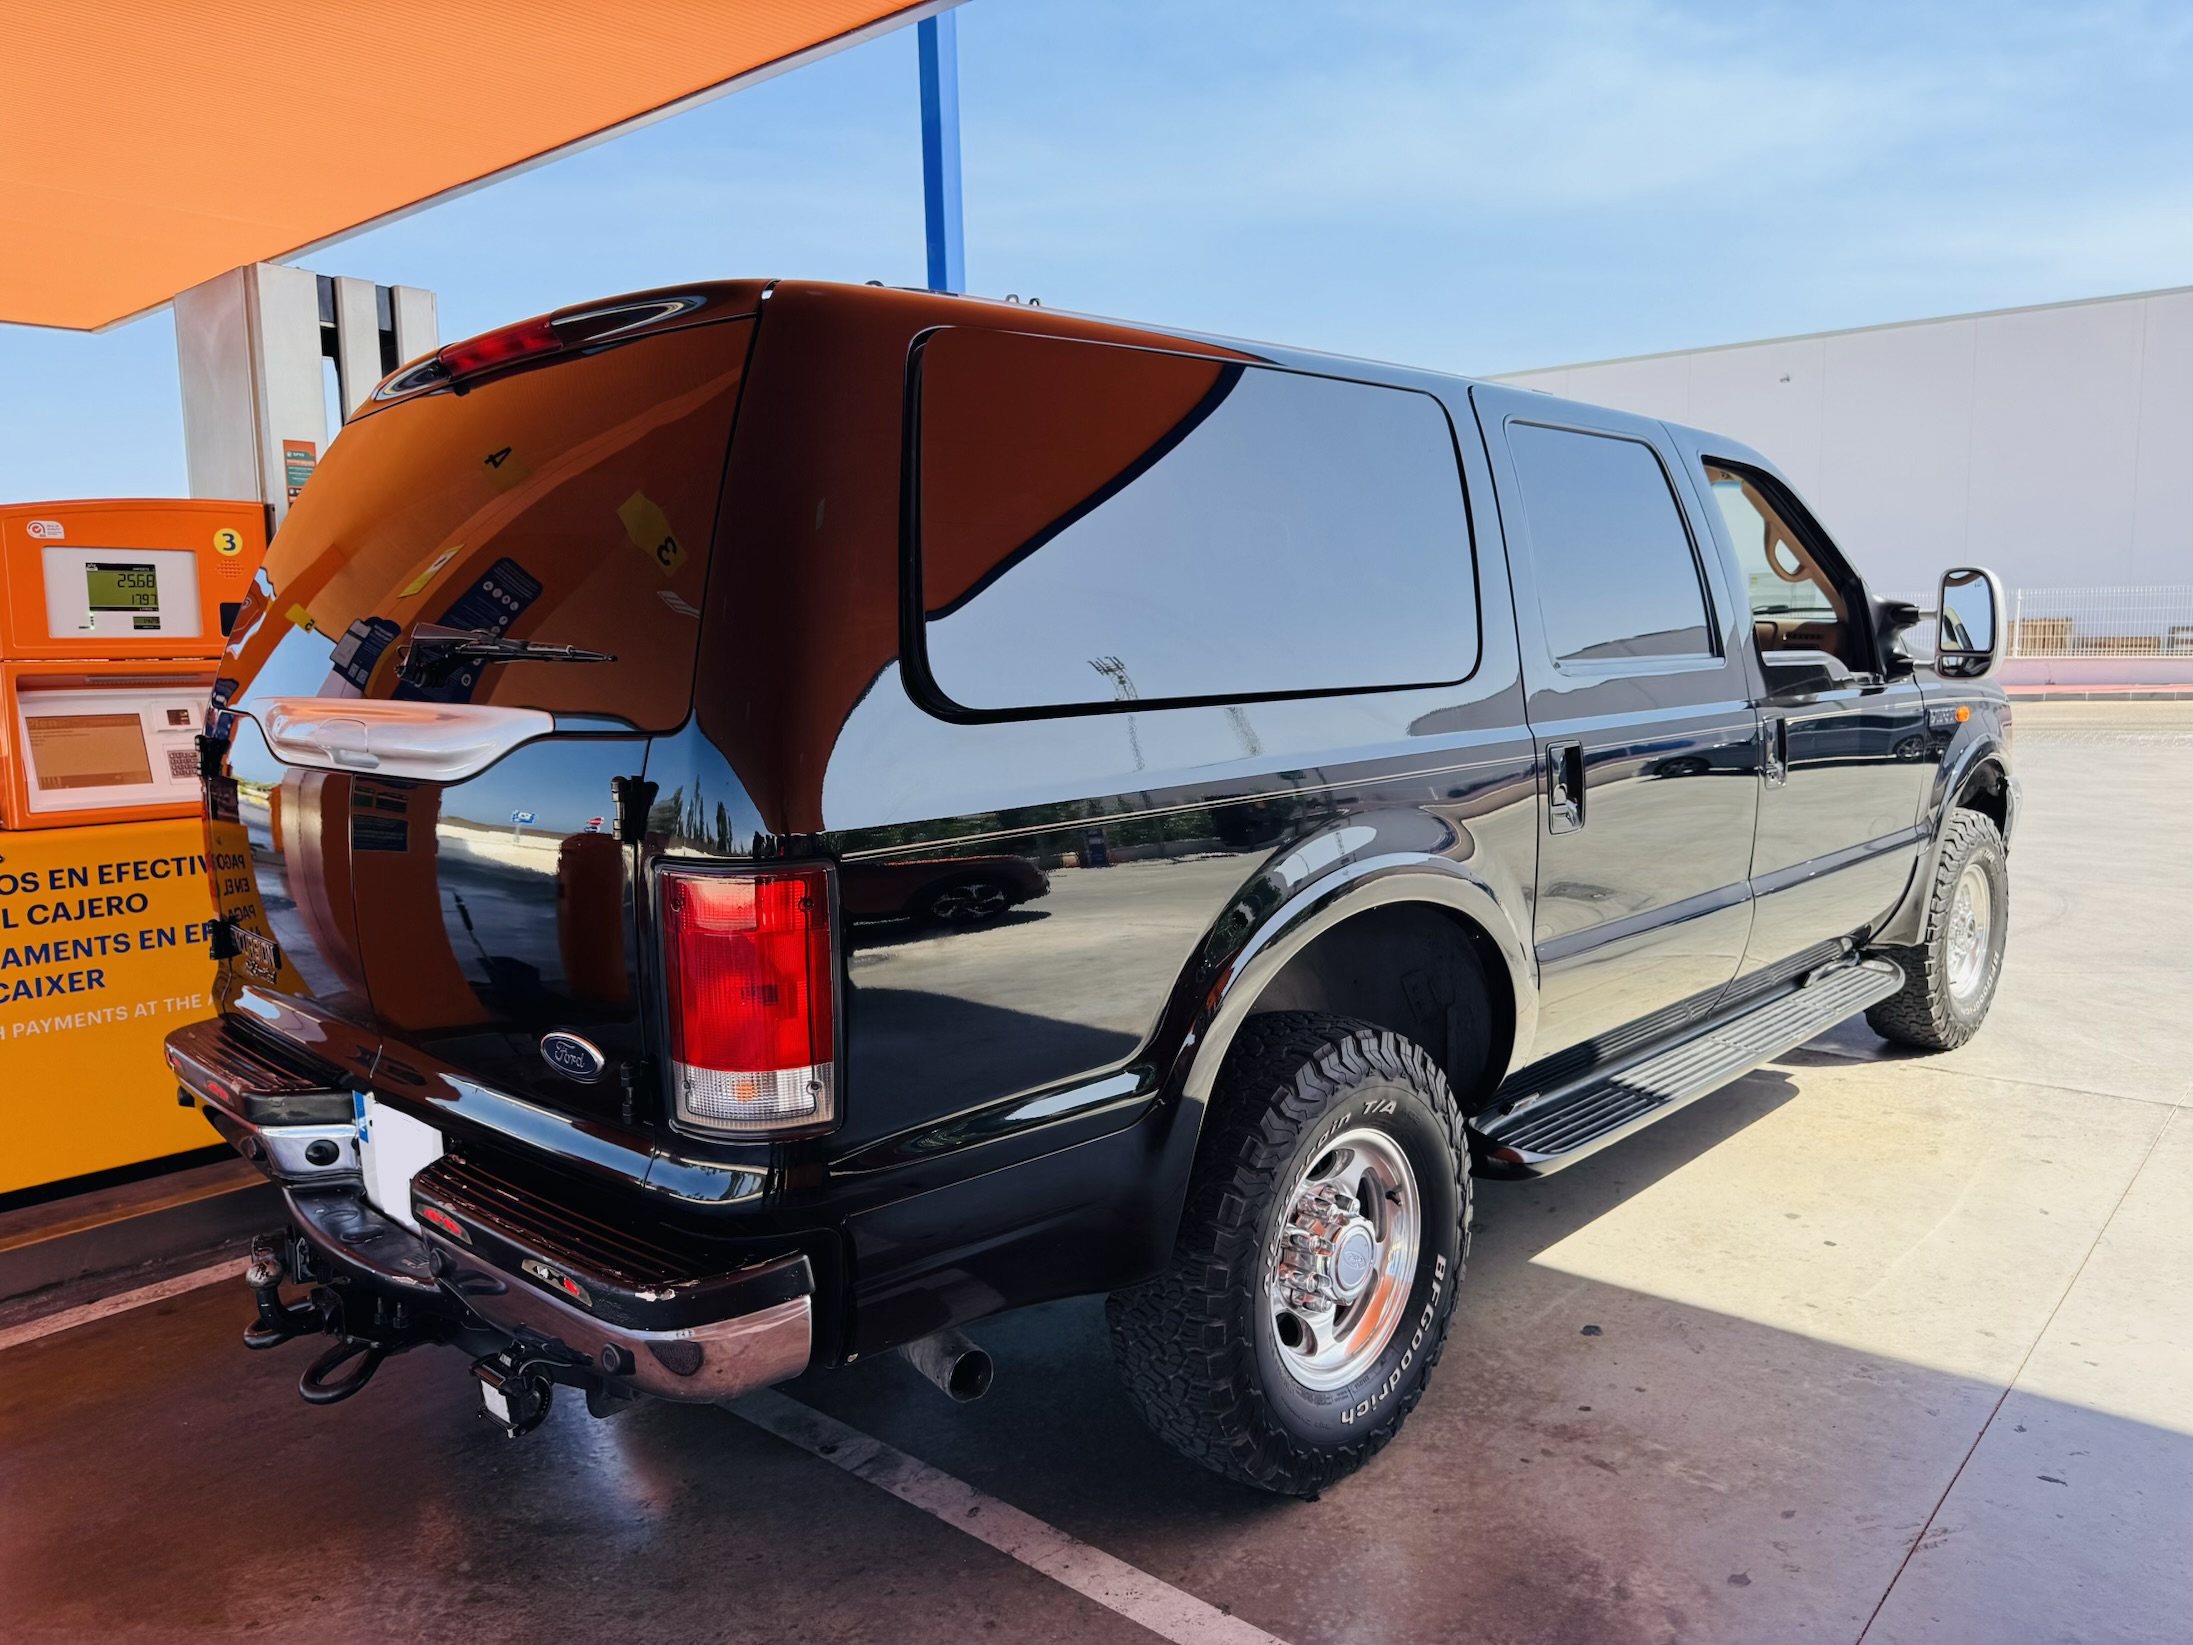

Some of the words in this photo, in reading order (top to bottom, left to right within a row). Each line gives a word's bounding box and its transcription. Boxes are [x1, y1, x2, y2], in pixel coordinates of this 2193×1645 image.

[222, 533, 236, 551] 3
[48, 866, 88, 890] EN
[27, 893, 149, 926] CAJERO
[139, 926, 176, 950] EN
[12, 1006, 129, 1039] PAYMENTS
[133, 1000, 158, 1018] AT
[163, 993, 202, 1013] THE
[555, 1040, 585, 1069] Ford
[1362, 1099, 1398, 1116] T/A
[1340, 1252, 1447, 1426] BFGoodrich
